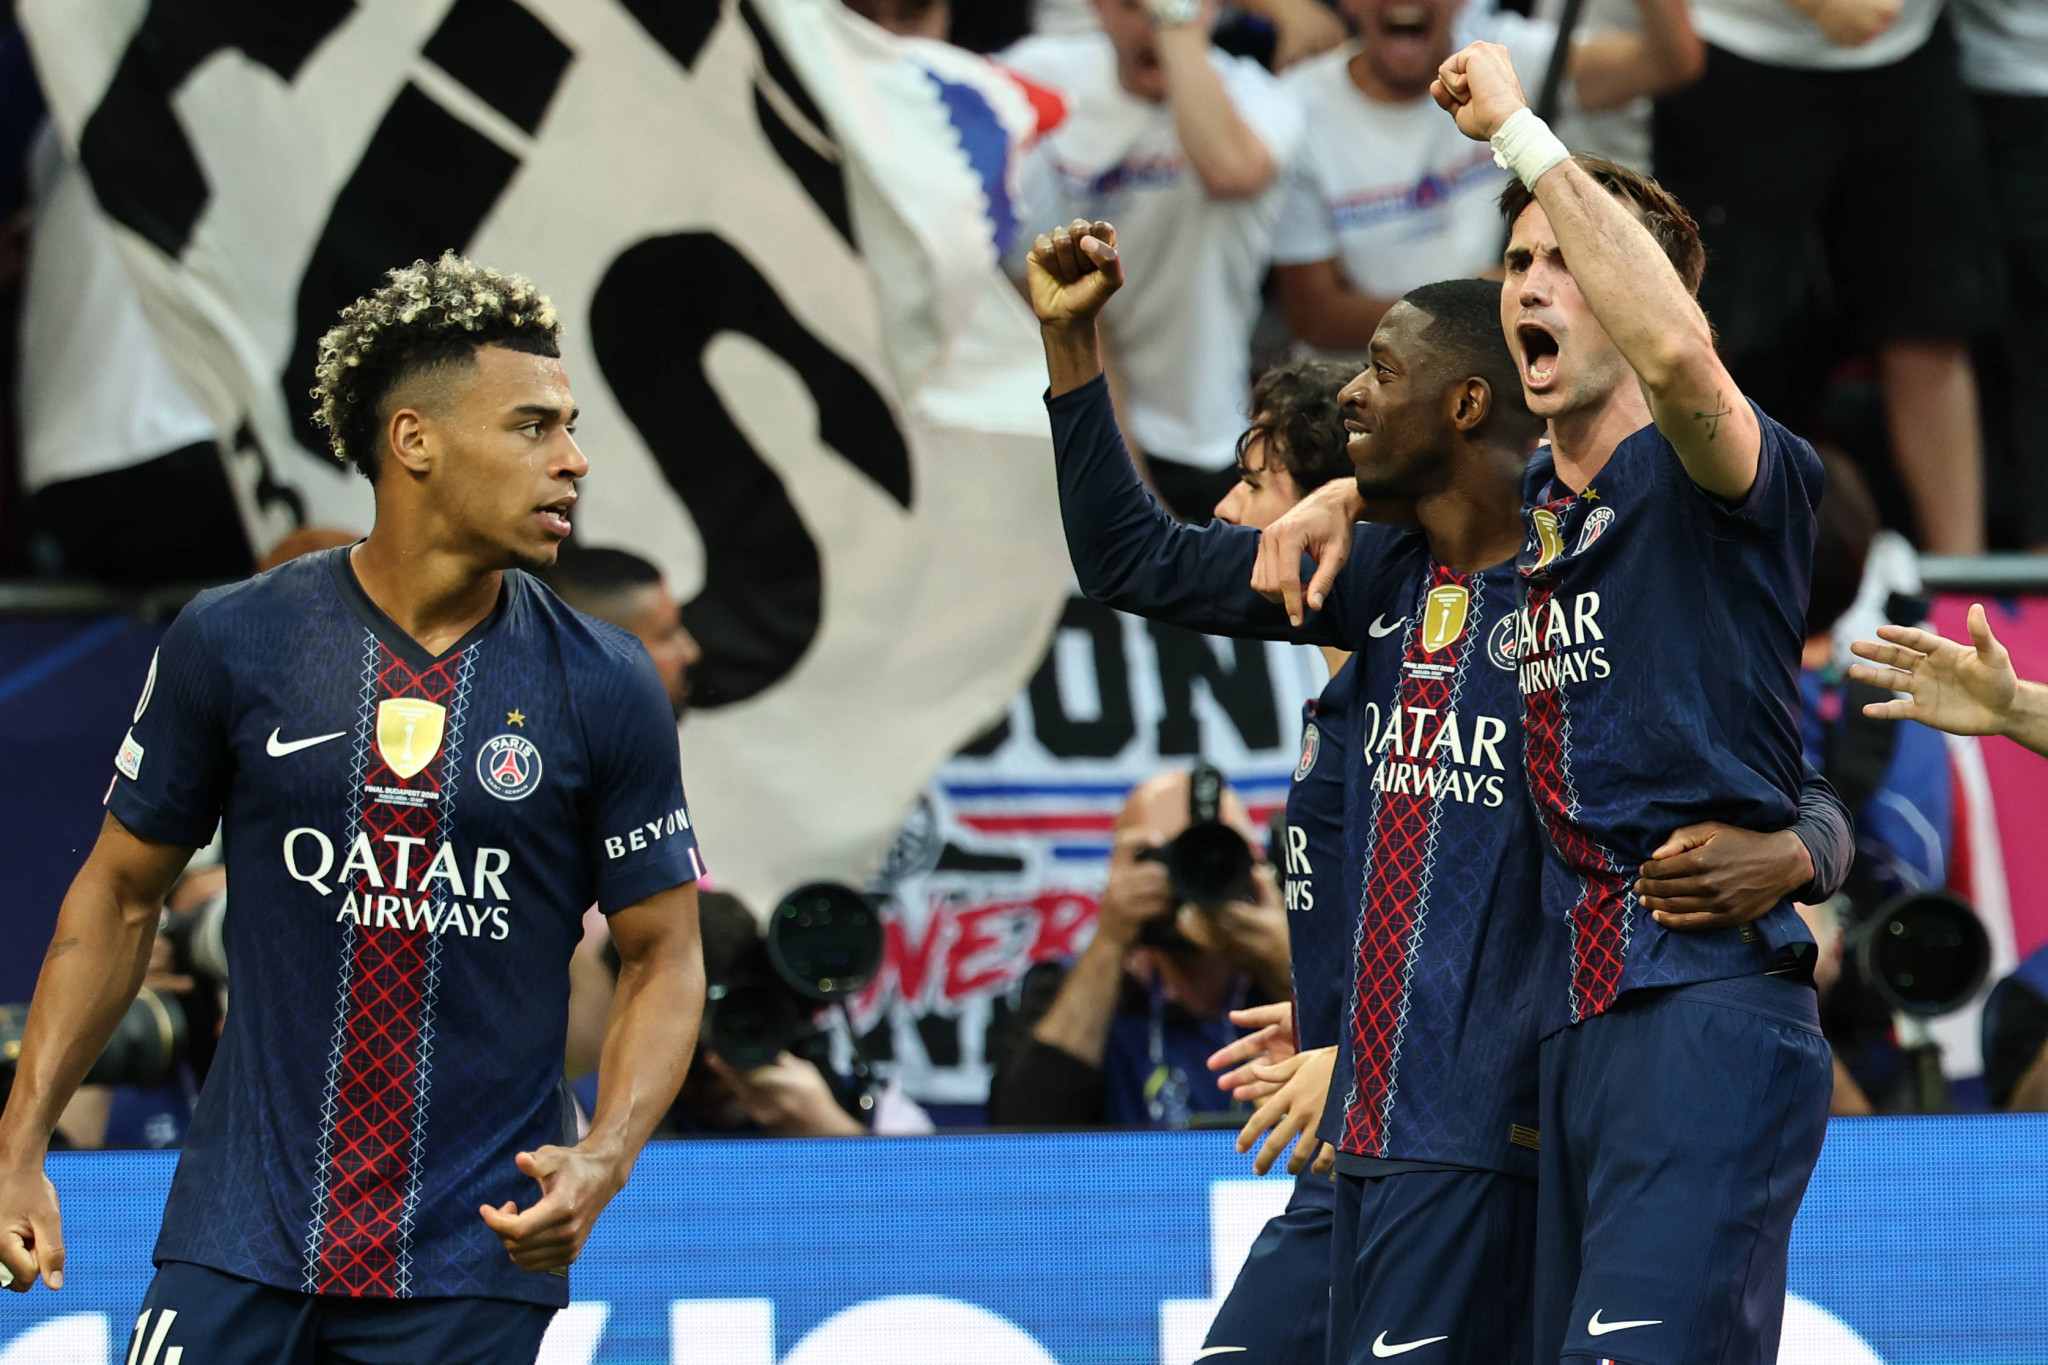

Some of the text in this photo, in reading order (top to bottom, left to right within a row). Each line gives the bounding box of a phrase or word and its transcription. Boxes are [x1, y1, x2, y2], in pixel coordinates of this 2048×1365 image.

[1585, 510, 1611, 531] PARIS
[955, 596, 1282, 759] ON
[1518, 646, 1611, 695] AIRWAYS
[490, 738, 533, 757] PARIS
[1364, 702, 1507, 771] QATAR
[364, 785, 384, 793] FINAL
[384, 786, 421, 797] BUDAPEST
[1370, 760, 1505, 808] AIRWAYS
[604, 808, 692, 860] BEYON
[283, 827, 511, 901] QATAR
[336, 890, 510, 941] AIRWAYS
